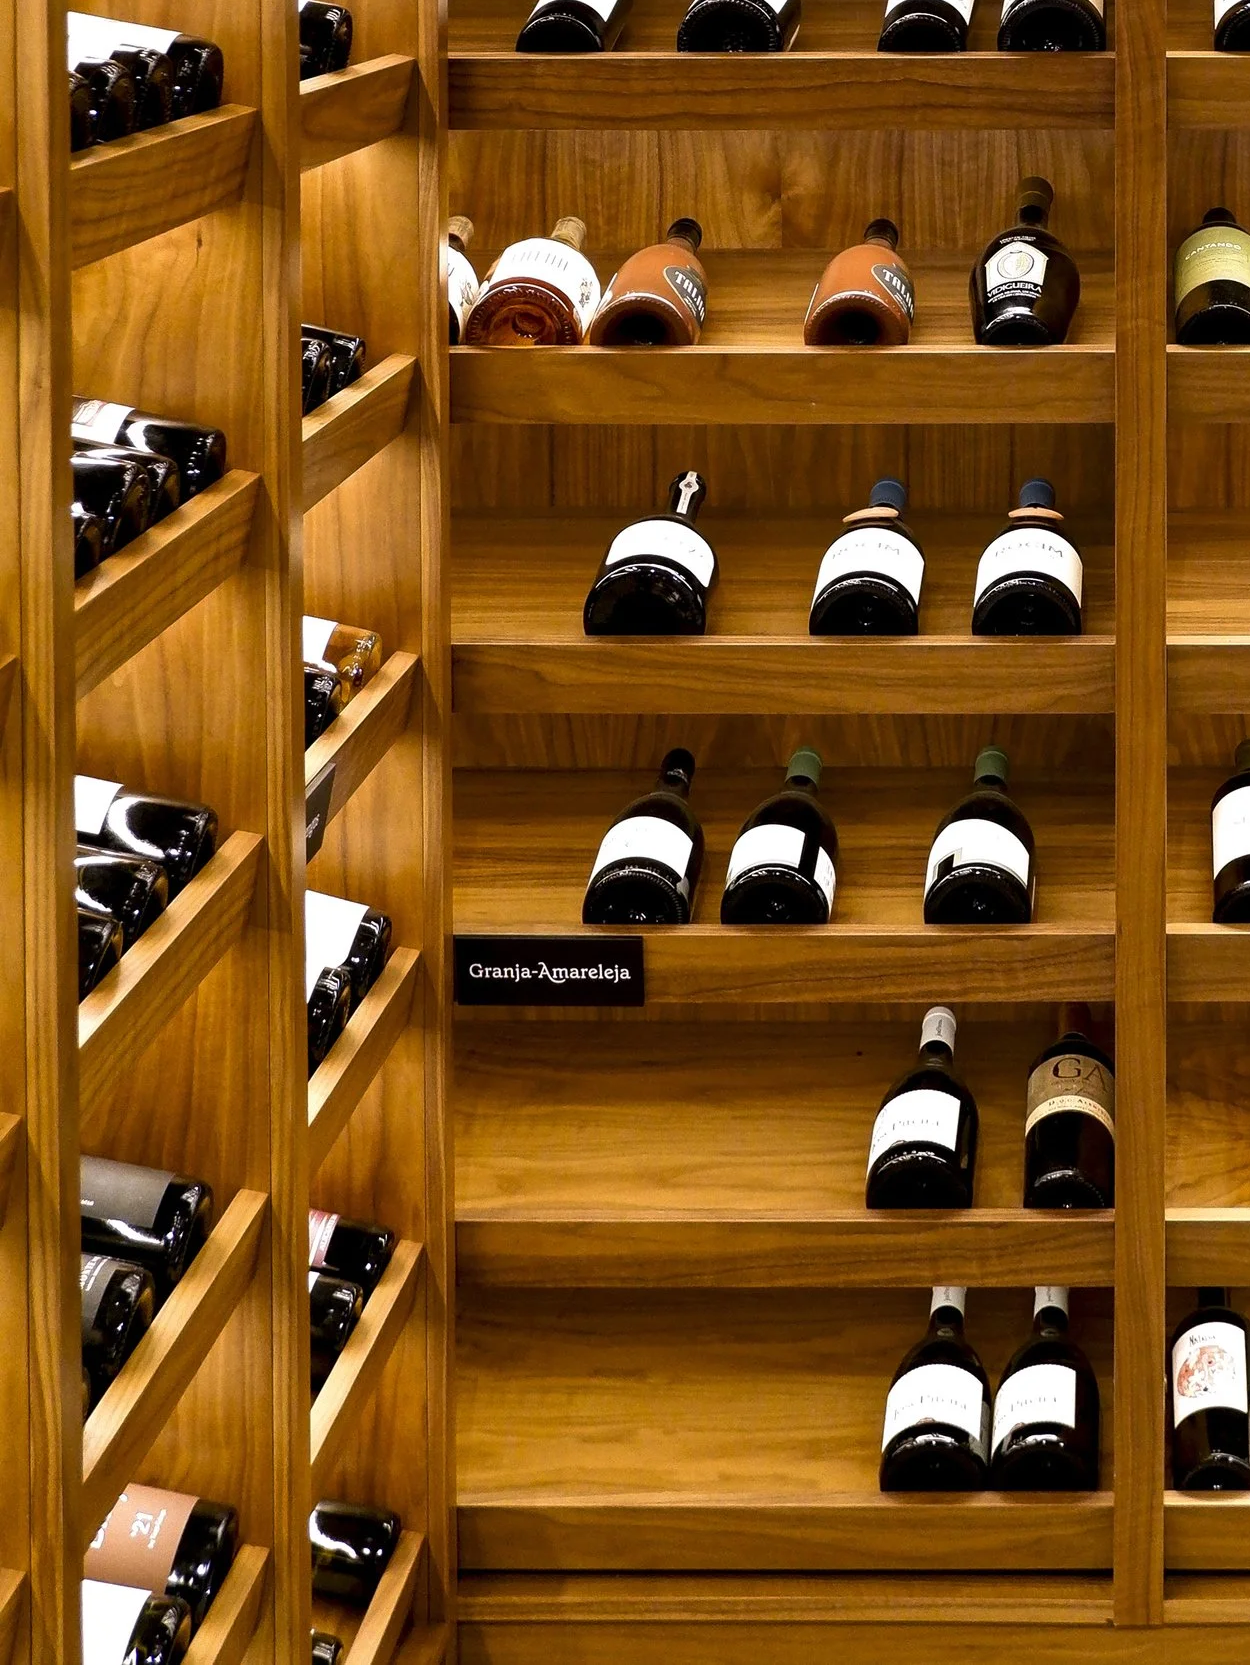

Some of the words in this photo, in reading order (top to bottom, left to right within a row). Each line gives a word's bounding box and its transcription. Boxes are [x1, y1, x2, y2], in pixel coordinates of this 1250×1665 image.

[1185, 241, 1242, 261] CANTANDO
[986, 281, 1043, 298] VIDIGUEIRA
[469, 961, 632, 984] Granja-Amareleja
